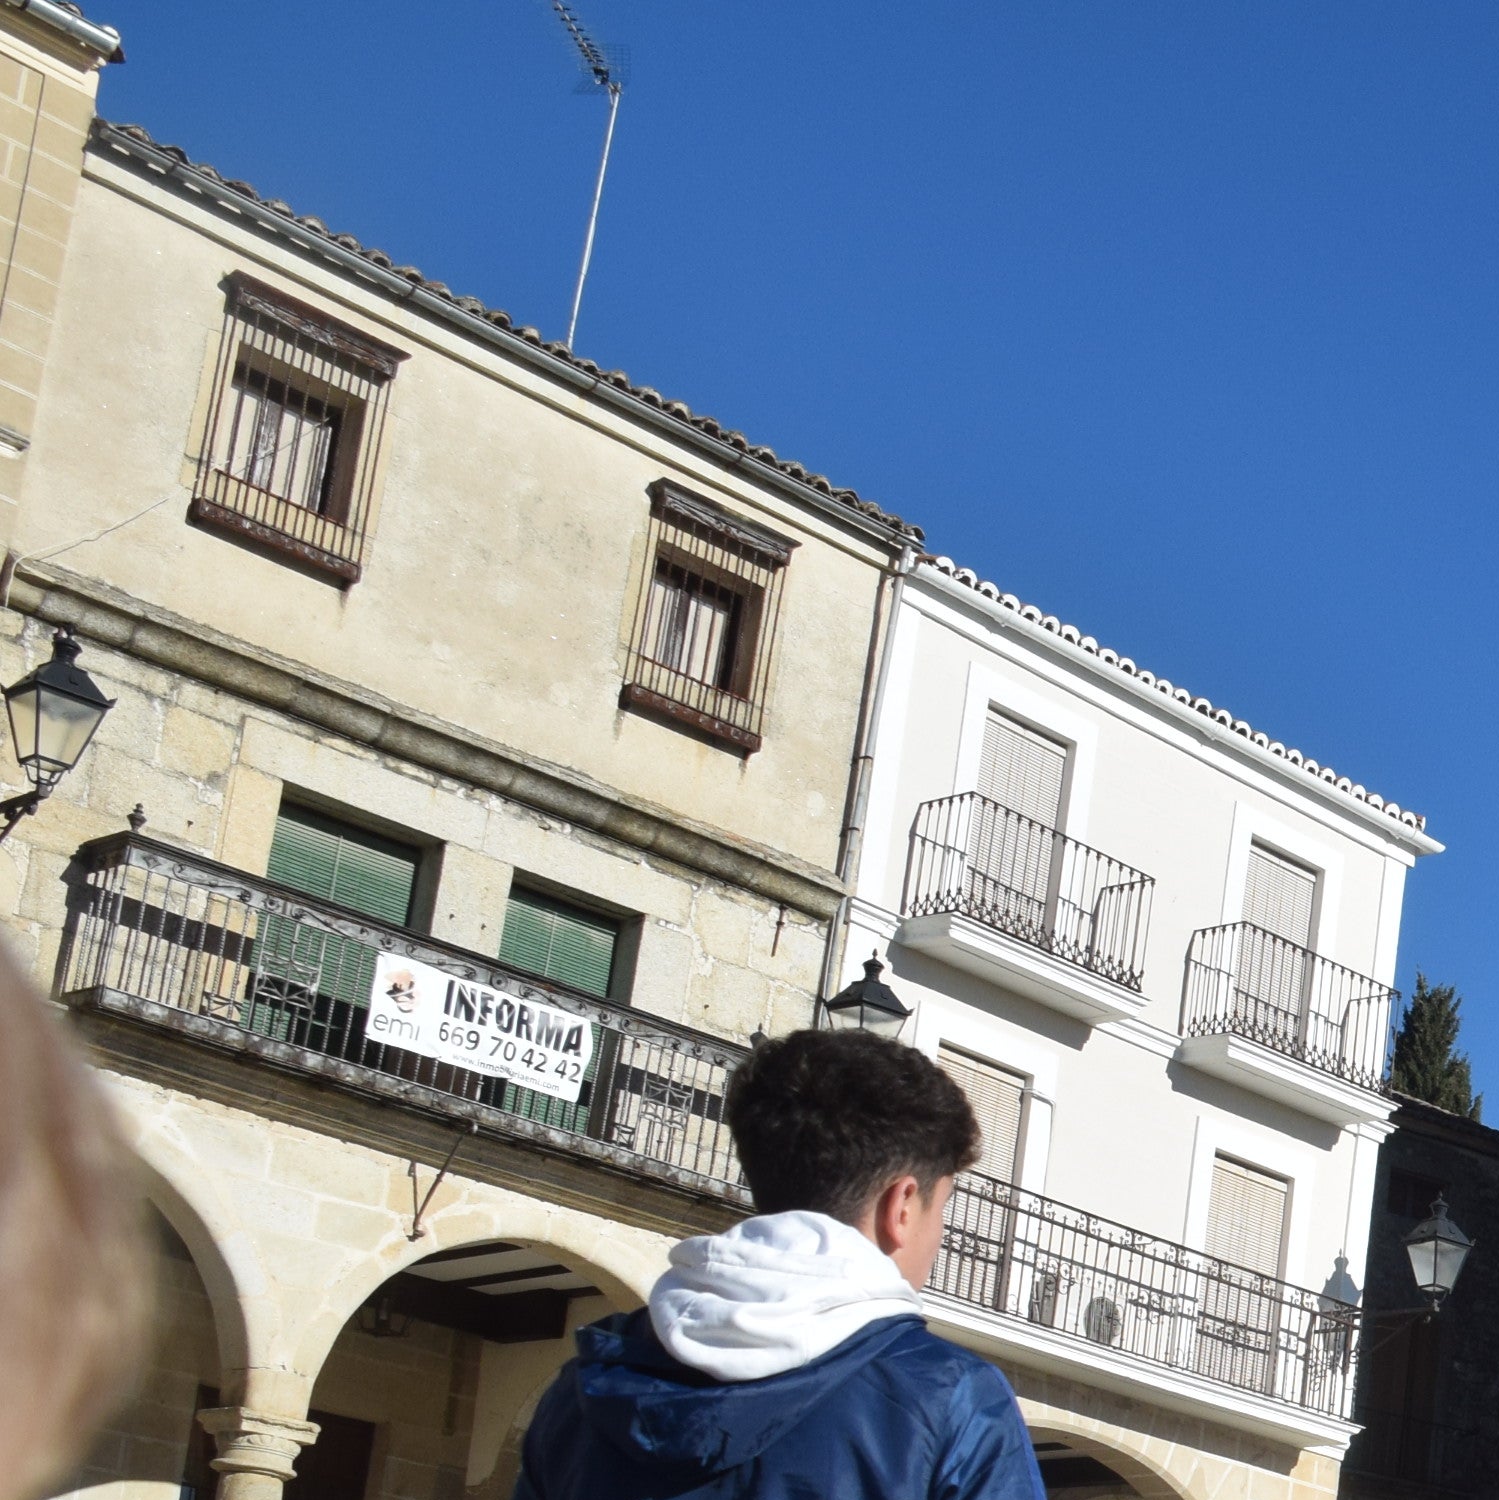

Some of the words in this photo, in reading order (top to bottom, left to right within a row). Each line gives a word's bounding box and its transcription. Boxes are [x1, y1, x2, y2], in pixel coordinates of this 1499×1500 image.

[372, 1013, 420, 1041] emi
[443, 979, 584, 1058] INFORMA
[438, 1021, 481, 1051] 669
[489, 1035, 517, 1062] 70
[521, 1048, 548, 1073] 42
[554, 1059, 582, 1084] 42
